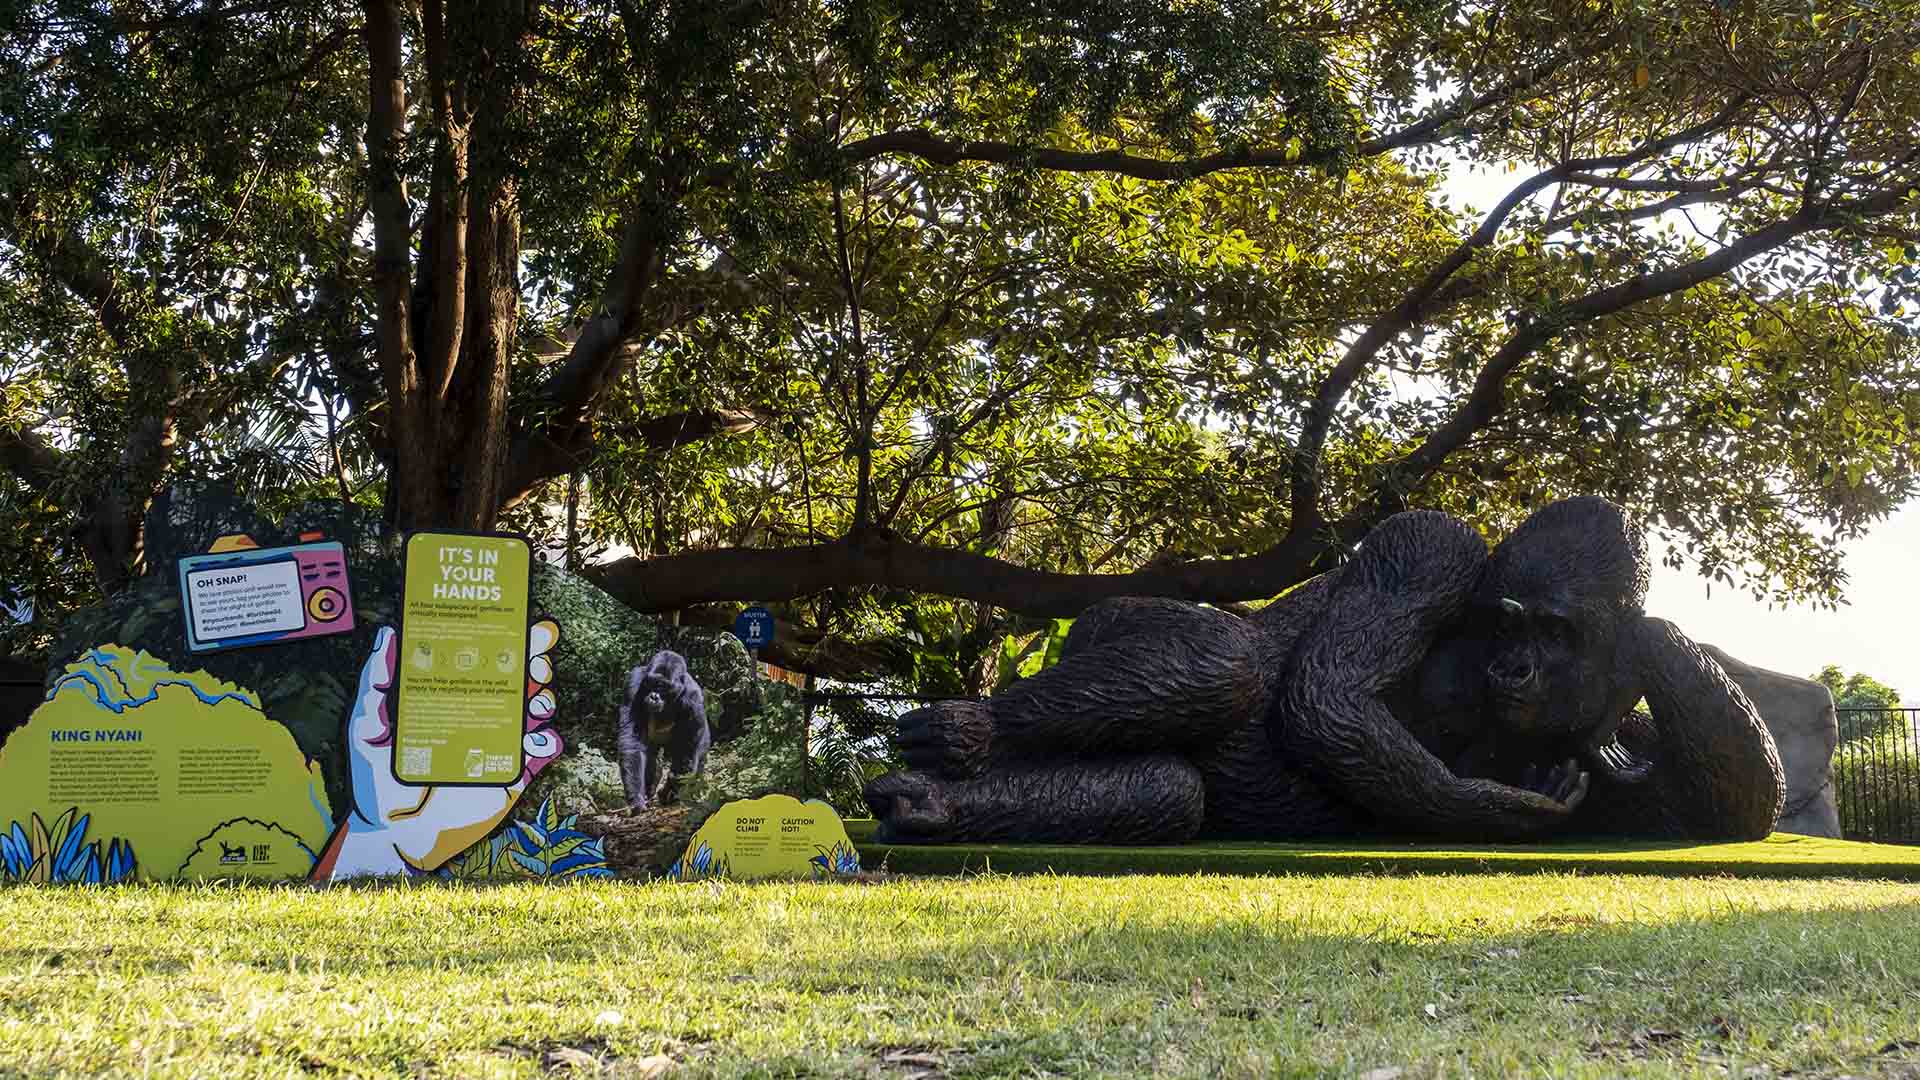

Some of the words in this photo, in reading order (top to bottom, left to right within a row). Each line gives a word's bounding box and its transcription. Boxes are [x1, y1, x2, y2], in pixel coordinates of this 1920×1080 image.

[440, 546, 473, 563] IT'S
[479, 549, 498, 564] IN
[197, 579, 214, 588] OH
[216, 574, 247, 586] SNAP!
[440, 566, 496, 583] YOUR
[433, 584, 502, 601] HANDS
[51, 730, 91, 742] KING
[95, 730, 143, 742] NYANI
[736, 817, 748, 825] DO
[749, 817, 766, 825] NOT
[781, 818, 815, 826] CAUTION
[736, 825, 759, 833] CLIMB
